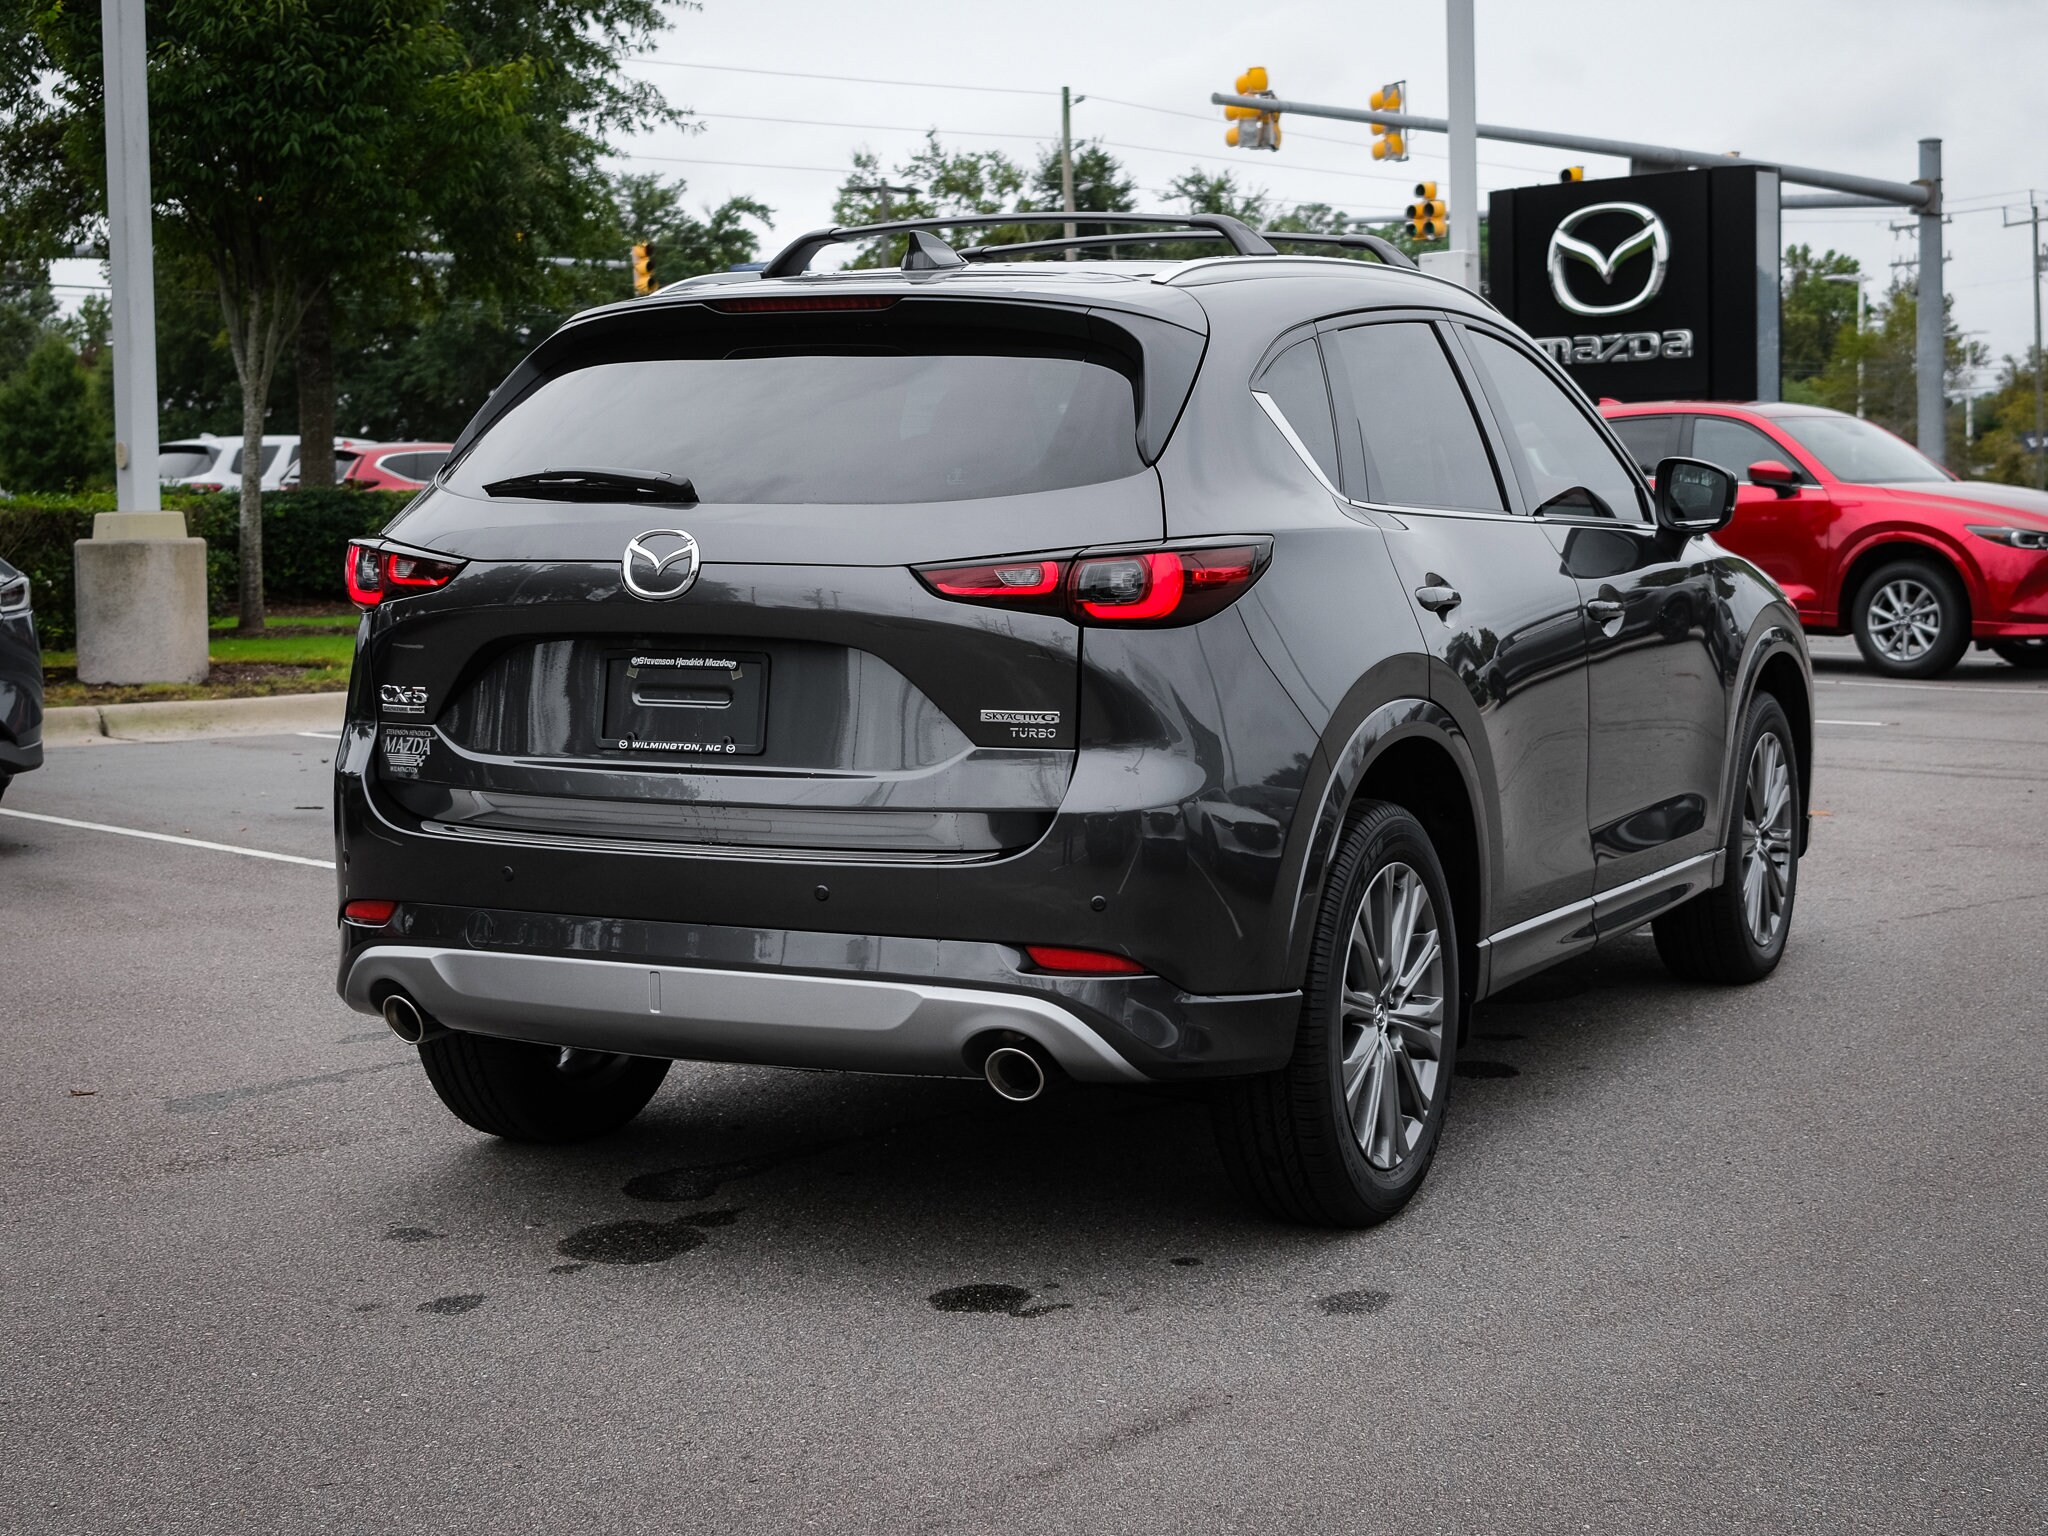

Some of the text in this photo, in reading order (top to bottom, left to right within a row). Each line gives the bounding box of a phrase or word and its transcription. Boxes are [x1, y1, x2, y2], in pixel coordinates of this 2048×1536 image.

[639, 656, 731, 668] Stevenson Hendrick Mazda
[380, 684, 429, 704] CX-5
[1009, 727, 1057, 739] TURBO
[383, 736, 431, 755] MAZDA
[632, 741, 722, 752] WILMINGTON, NC
